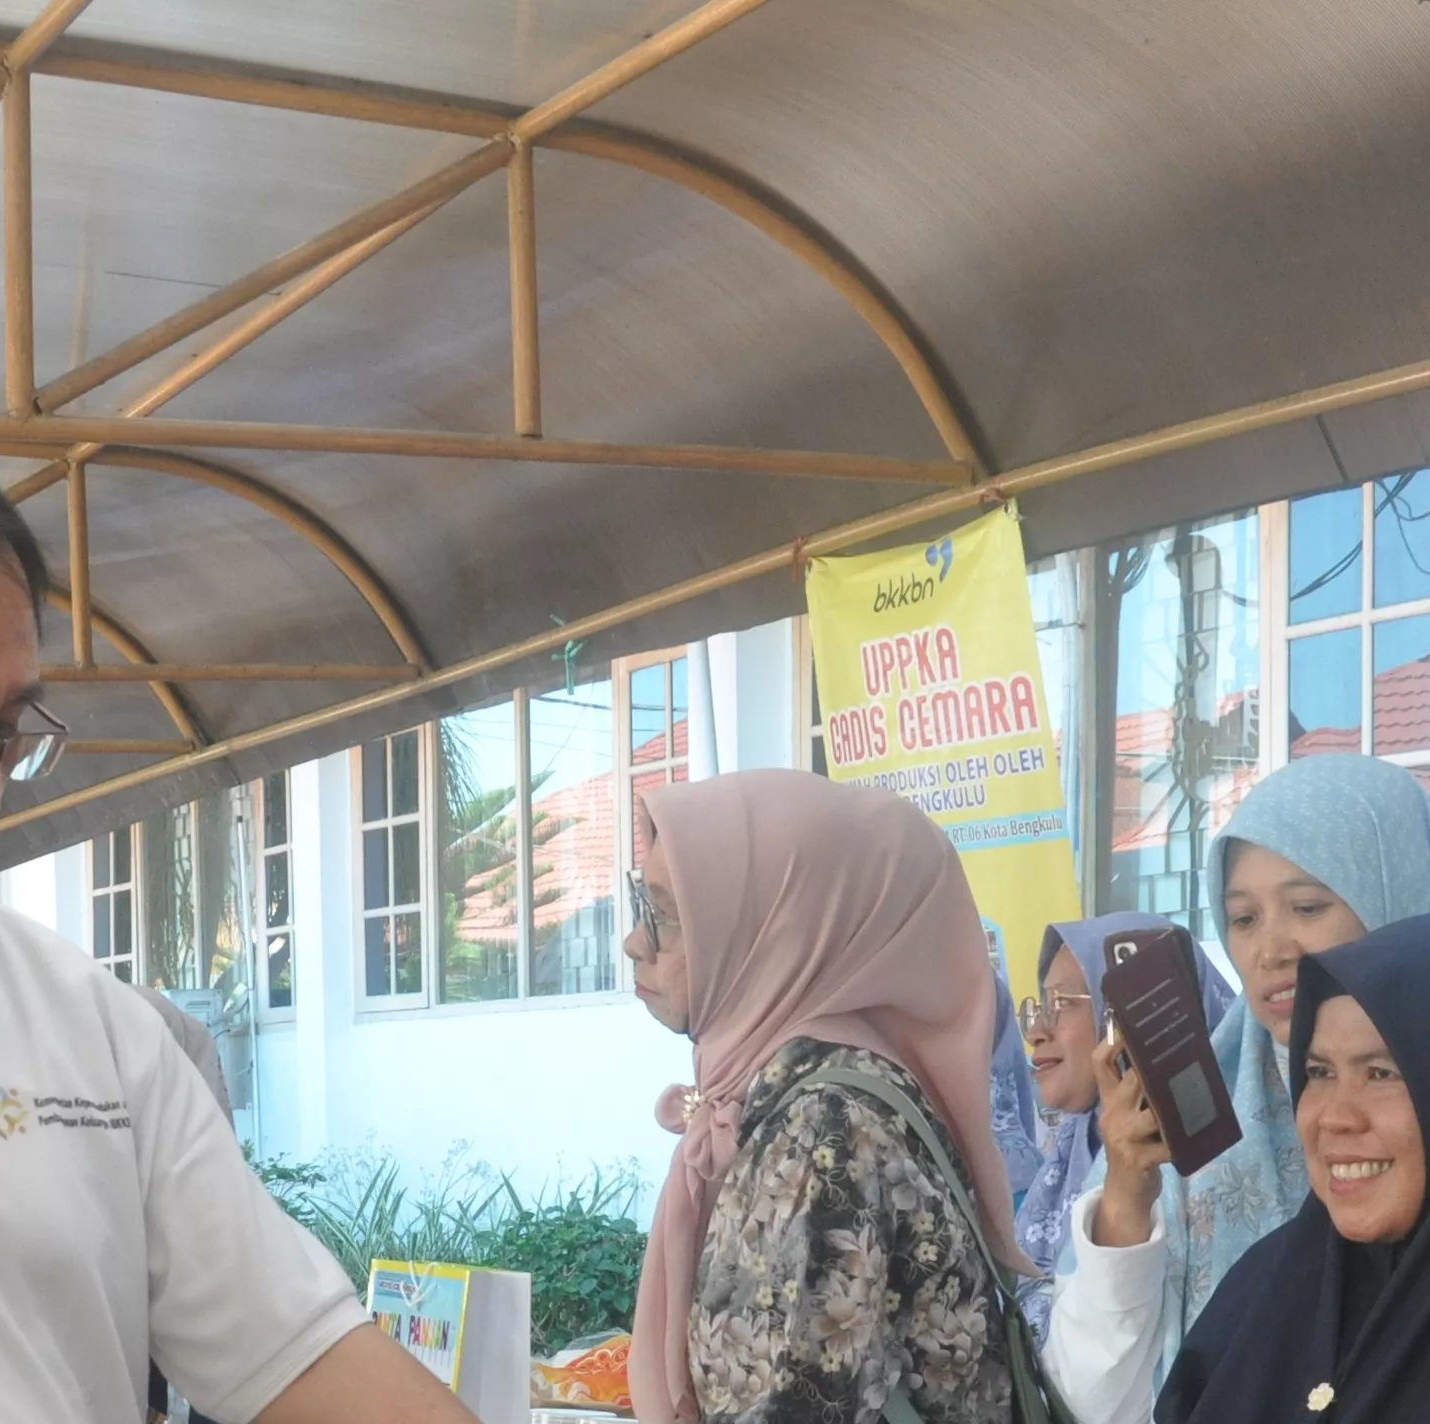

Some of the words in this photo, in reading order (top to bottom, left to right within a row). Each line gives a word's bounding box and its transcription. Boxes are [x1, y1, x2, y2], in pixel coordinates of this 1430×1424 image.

[873, 572, 935, 614] bkkbn
[861, 627, 960, 696] UPPKA
[898, 674, 1038, 751] CEMARA
[945, 755, 989, 784] OLEH
[993, 747, 1046, 776] OLEH
[983, 823, 1009, 842] Kota
[1010, 813, 1063, 838] Bengkulu
